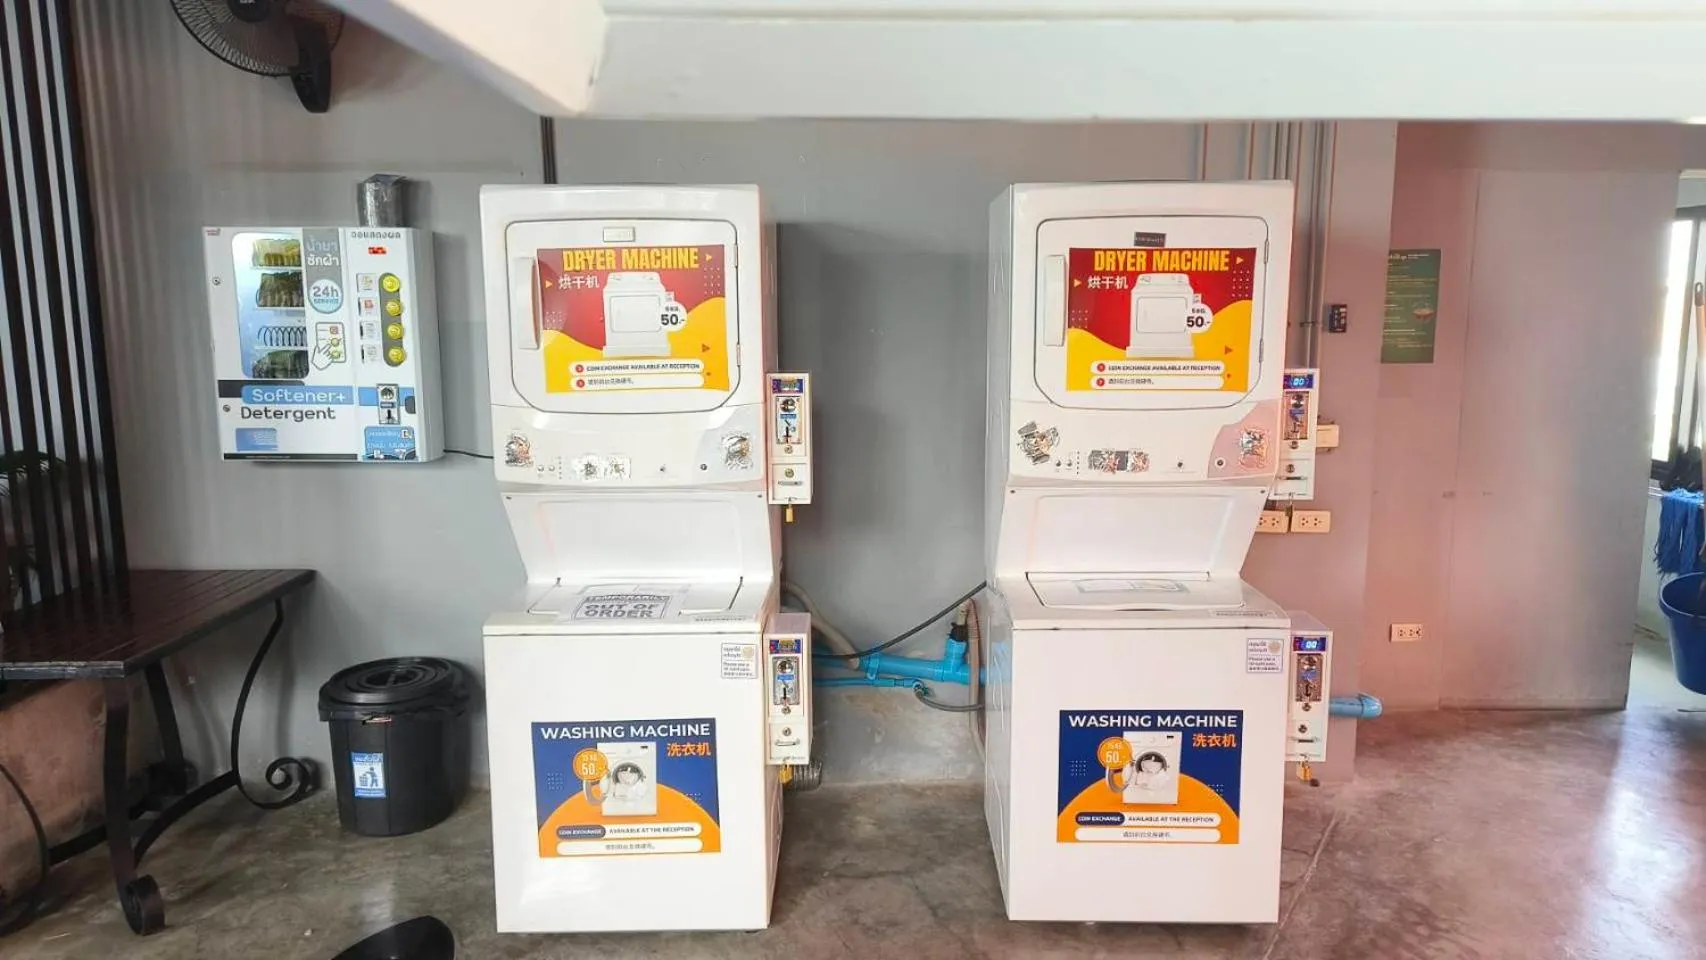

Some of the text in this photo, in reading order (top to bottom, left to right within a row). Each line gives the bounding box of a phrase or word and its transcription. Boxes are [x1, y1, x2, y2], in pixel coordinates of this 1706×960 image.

[306, 252, 340, 266] ซักผ้า
[563, 247, 700, 272] DRYER MACHINE
[1094, 250, 1230, 272] DRYER MACHINE
[558, 274, 600, 290] 烘干机
[1087, 275, 1129, 290] 烘干机
[312, 285, 339, 298] 24h
[252, 387, 346, 403] Softener+
[240, 406, 336, 423] Detergent
[584, 609, 653, 618] ORDER
[1068, 715, 1238, 728] WASHING MACHINE
[540, 723, 711, 740] WASHING MACHINE
[1192, 733, 1237, 748] 洗衣机
[667, 742, 711, 757] 洗衣机
